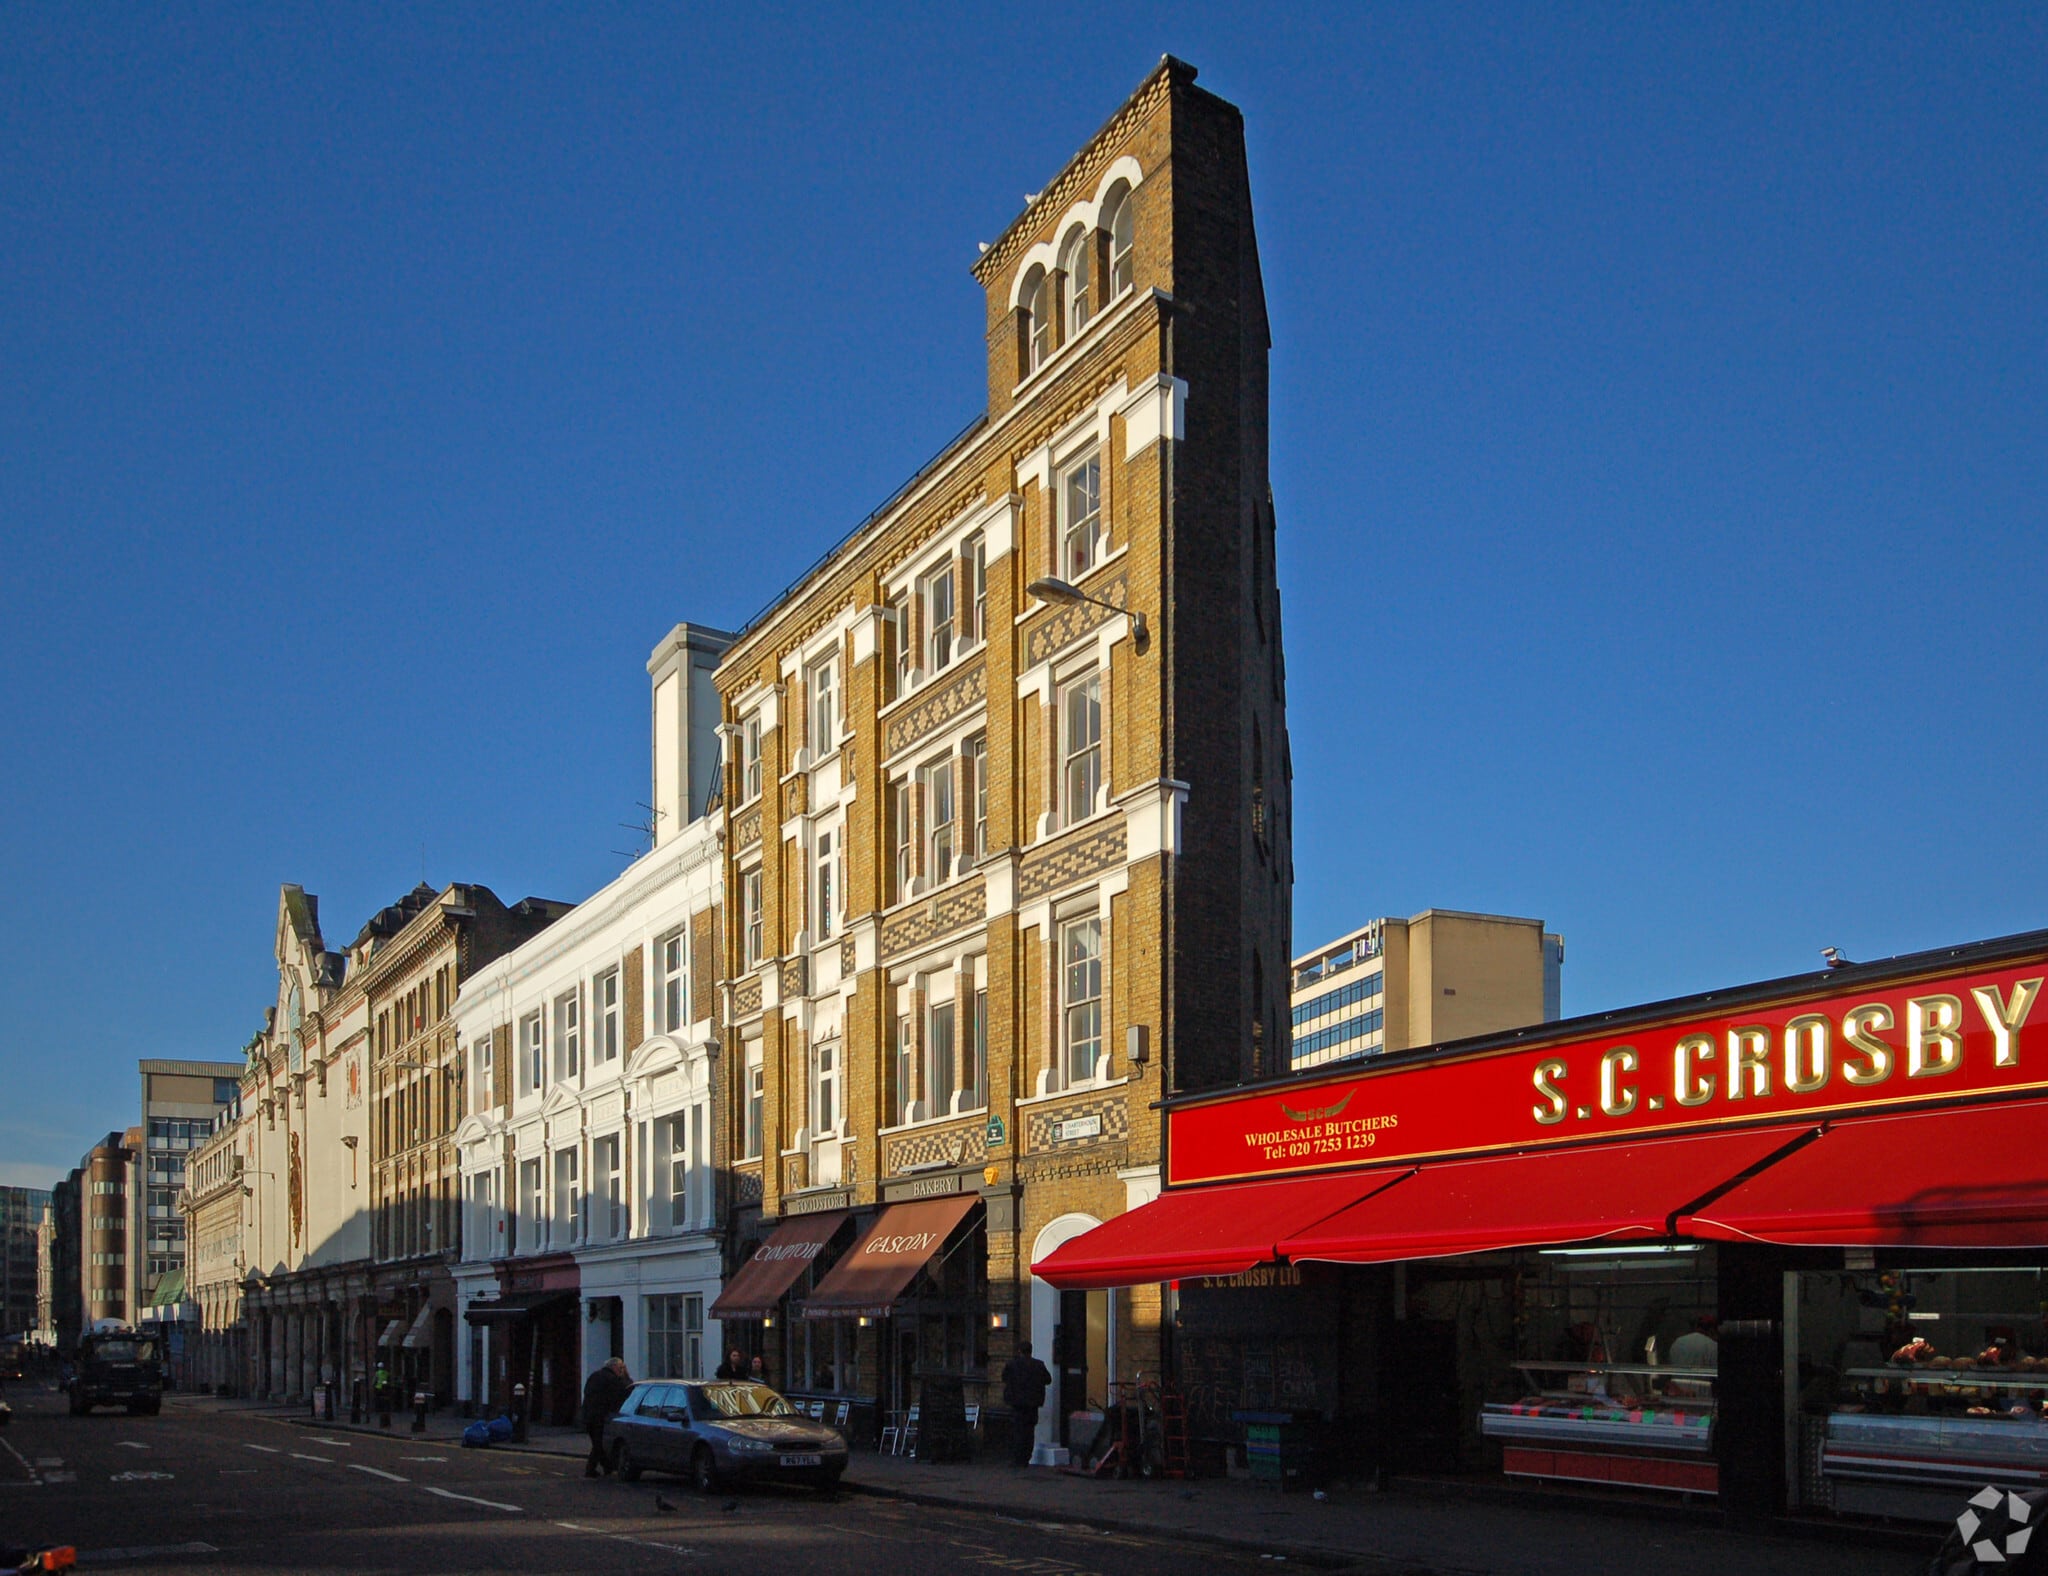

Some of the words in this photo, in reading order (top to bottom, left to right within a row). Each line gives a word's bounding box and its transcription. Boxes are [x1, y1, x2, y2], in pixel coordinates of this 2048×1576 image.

[1264, 1146, 1287, 1160] Tel:
[1289, 1141, 1311, 1157] 020
[1313, 1137, 1343, 1154] 7253
[1346, 1132, 1376, 1150] 1239
[913, 1177, 954, 1197] BAKERY
[798, 1193, 846, 1213] FOODSTORE
[754, 1242, 825, 1262] COMPTOIR
[865, 1232, 937, 1255] GASCON
[1229, 1268, 1276, 1288] CROSBY
[1280, 1266, 1301, 1286] LTD
